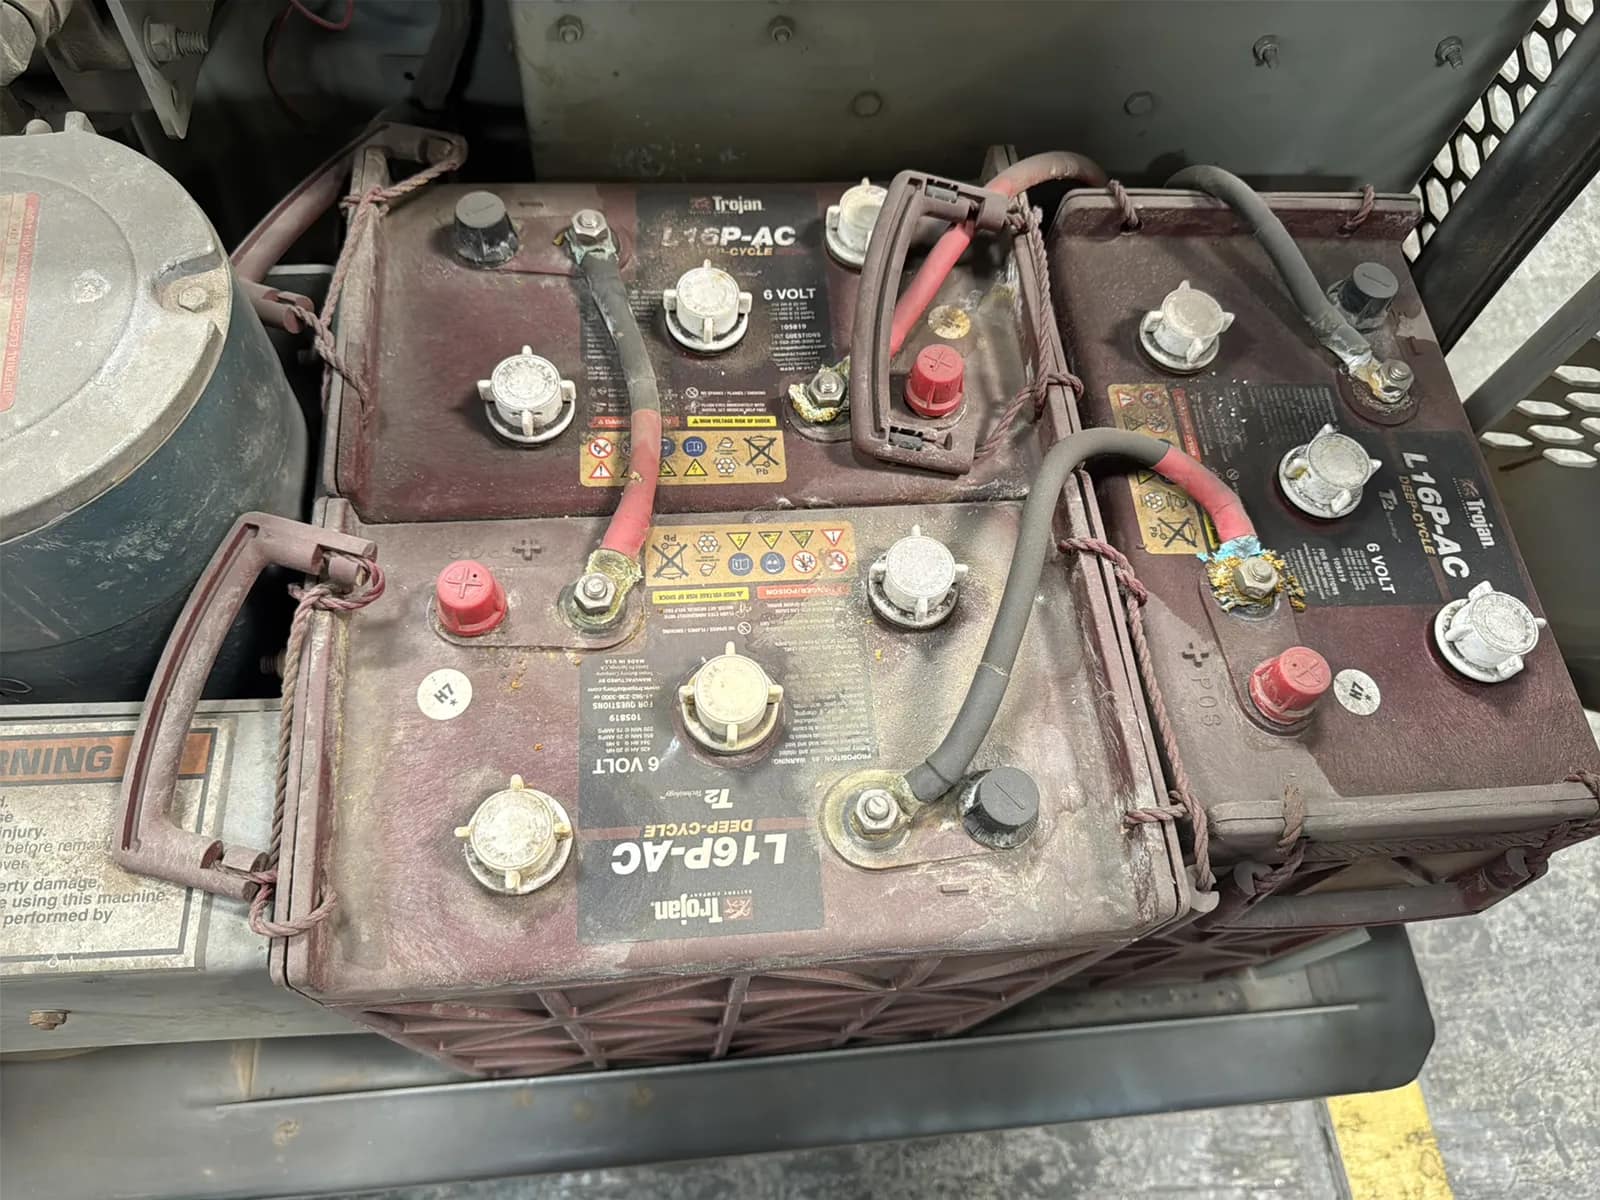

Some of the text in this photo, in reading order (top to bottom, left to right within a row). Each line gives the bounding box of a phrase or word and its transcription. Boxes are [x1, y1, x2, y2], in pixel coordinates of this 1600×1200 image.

[712, 196, 763, 214] Trojan
[661, 226, 796, 246] L16P-AC
[763, 288, 816, 300] 6 VOLT
[756, 467, 769, 476] Pb
[1398, 475, 1436, 555] DEEP-CYCLE
[1402, 452, 1470, 578] L16P-AC
[1466, 498, 1496, 548] Trojan
[664, 534, 677, 542] Pb
[1366, 543, 1380, 552] 6
[1371, 555, 1396, 594] VOLT
[432, 681, 456, 704] H7
[1350, 681, 1364, 700] H7
[592, 701, 654, 710] FOR QUESTIONS
[608, 714, 642, 722] 105819
[0, 744, 114, 776] NING
[592, 756, 660, 774] 6 VOLT
[704, 788, 734, 810] T2
[644, 819, 754, 838] DEEP-CYCLE
[5, 841, 53, 855] before
[610, 833, 788, 876] L16P-AC
[12, 895, 58, 910] using
[62, 892, 92, 906] this
[654, 893, 723, 926] Trojan
[3, 908, 114, 928] performed by
